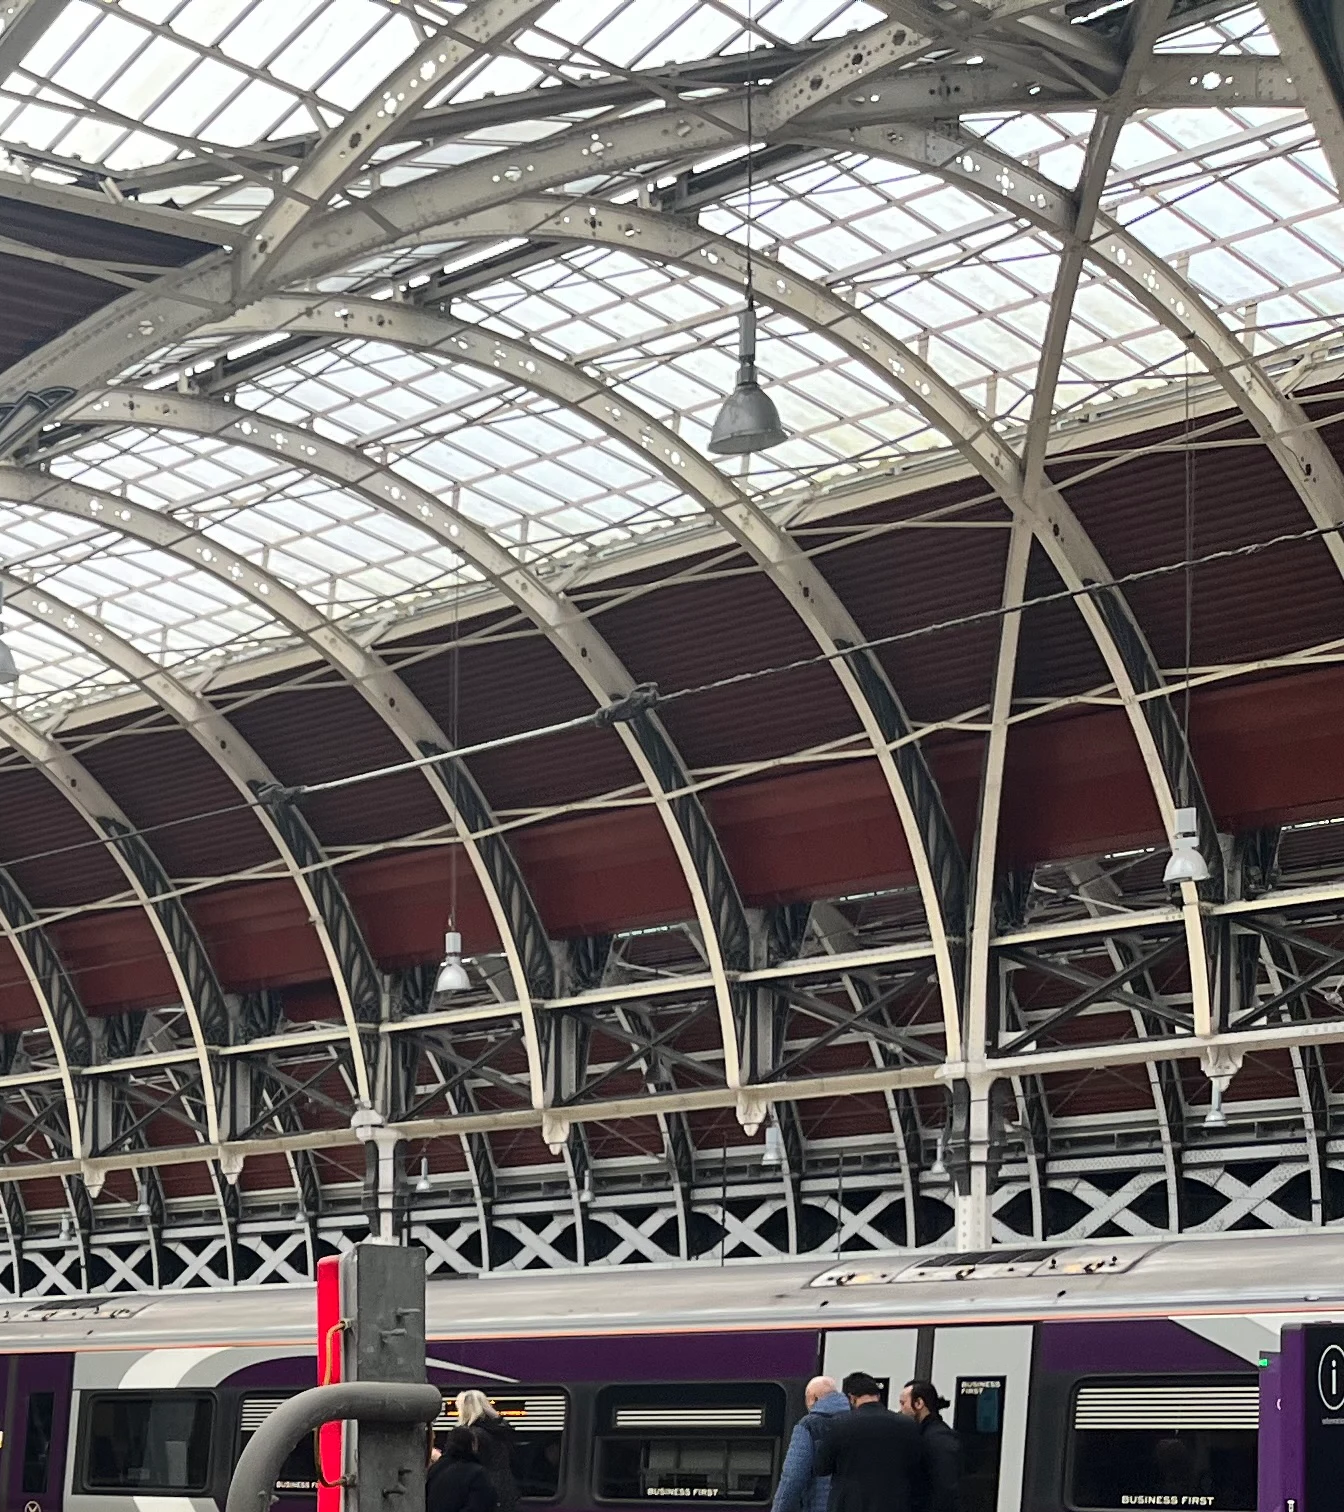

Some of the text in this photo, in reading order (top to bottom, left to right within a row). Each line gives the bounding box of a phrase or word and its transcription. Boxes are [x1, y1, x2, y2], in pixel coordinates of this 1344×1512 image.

[647, 1488, 719, 1497] BUSINESS FIRST
[1121, 1495, 1215, 1505] BUSINESS FIRST
